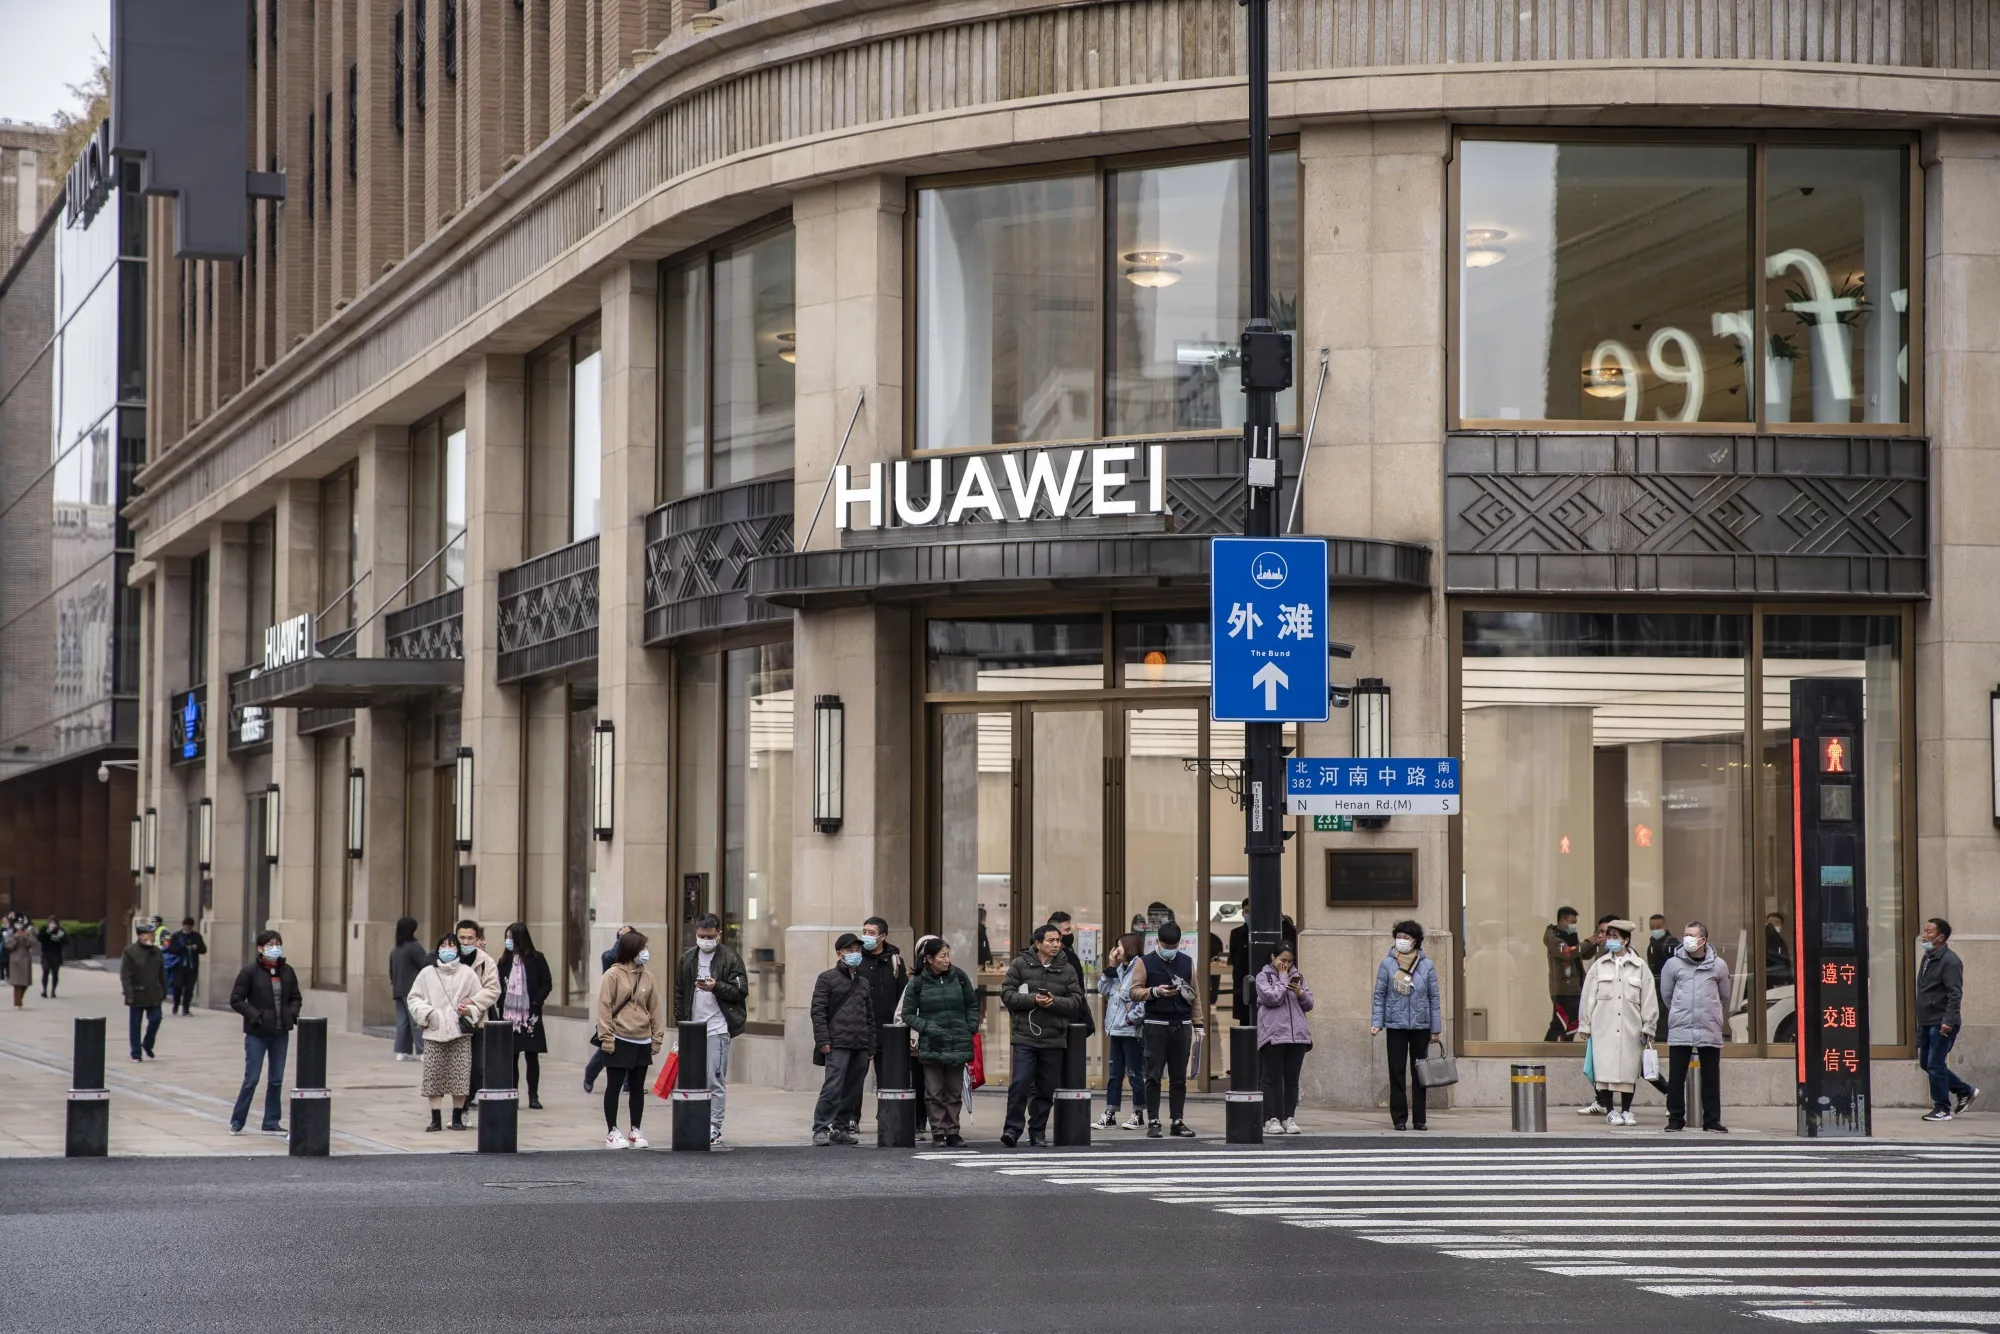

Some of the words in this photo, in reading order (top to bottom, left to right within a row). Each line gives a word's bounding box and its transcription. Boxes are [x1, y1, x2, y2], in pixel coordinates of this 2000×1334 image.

[835, 445, 1165, 529] HUAWEI
[1226, 602, 1314, 640] 外滩
[265, 613, 309, 671] HUAWEI
[1250, 649, 1266, 657] The
[1268, 649, 1290, 657] Bund
[1291, 778, 1312, 789] 382
[1434, 778, 1454, 789] 368
[1296, 761, 1308, 774] 北
[1319, 765, 1426, 787] 河南中路
[1438, 760, 1450, 774] 南
[1297, 799, 1307, 810] N
[1335, 799, 1370, 810] Henan
[1376, 799, 1412, 811] Rd.(M)
[1442, 799, 1449, 810] S
[1317, 815, 1339, 824] 233
[1821, 963, 1856, 984] 遵守
[1823, 1006, 1857, 1028] 交通
[1823, 1048, 1860, 1072] 信号
